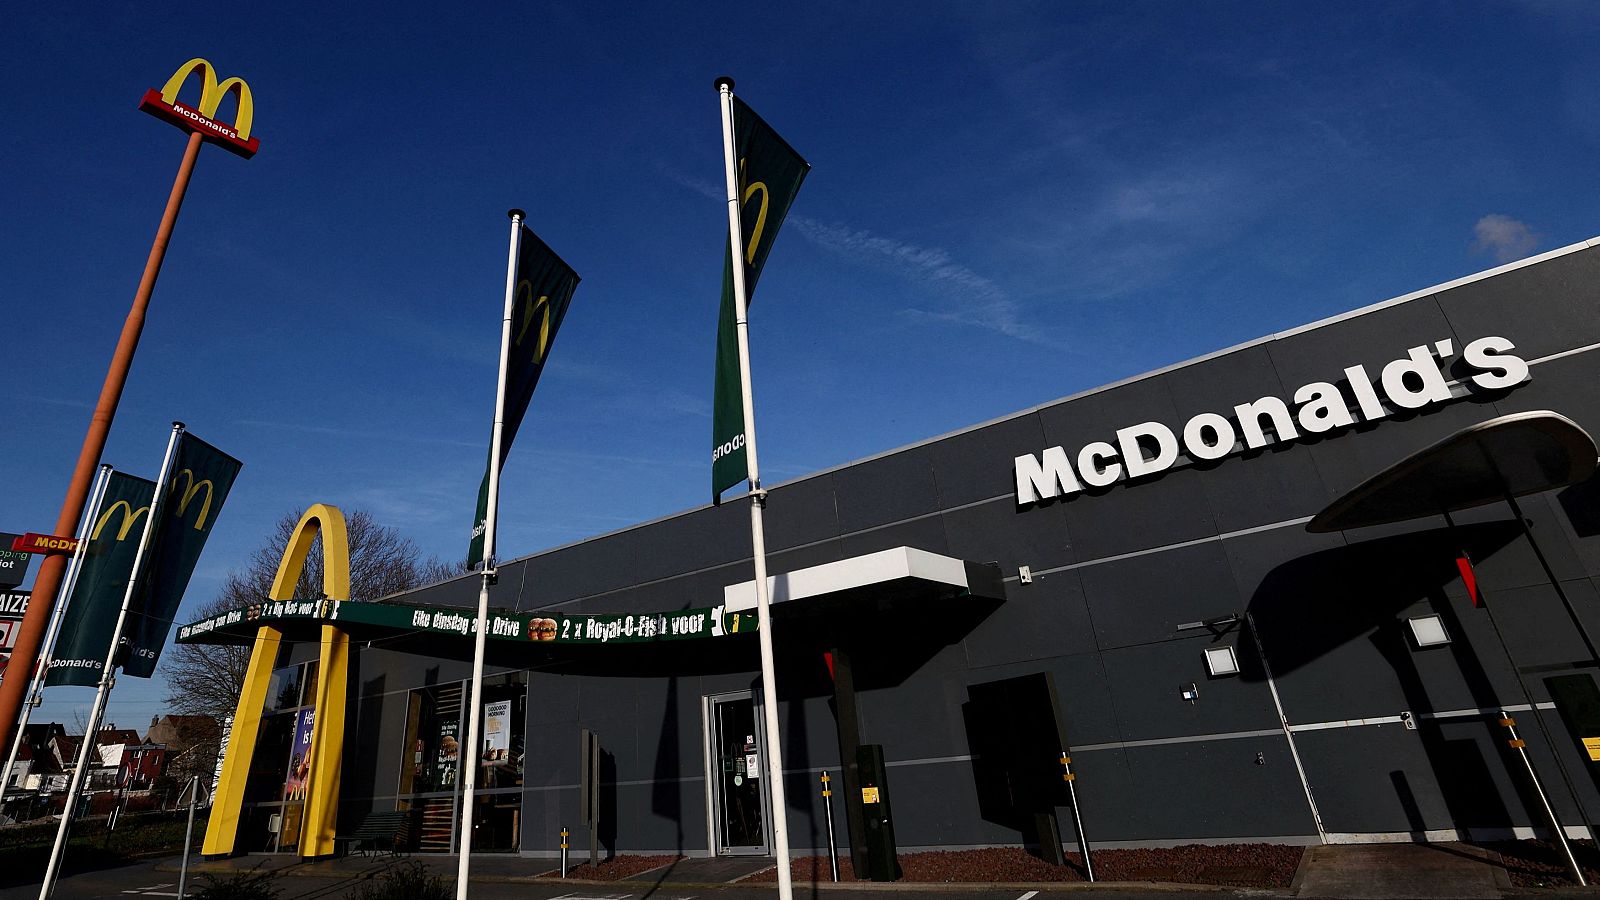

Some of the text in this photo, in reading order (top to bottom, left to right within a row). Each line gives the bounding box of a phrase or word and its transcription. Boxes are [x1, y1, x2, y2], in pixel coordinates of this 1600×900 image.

[173, 104, 236, 139] McDonald's
[1014, 336, 1530, 505] McDonald's
[412, 609, 431, 628] Elke
[432, 611, 470, 635] dinsdag
[492, 616, 520, 637] Drive
[561, 618, 571, 640] 2
[574, 622, 582, 640] x
[586, 613, 668, 643] Royal-O-Fish
[671, 613, 705, 636] voor
[50, 658, 102, 670] cDonald's
